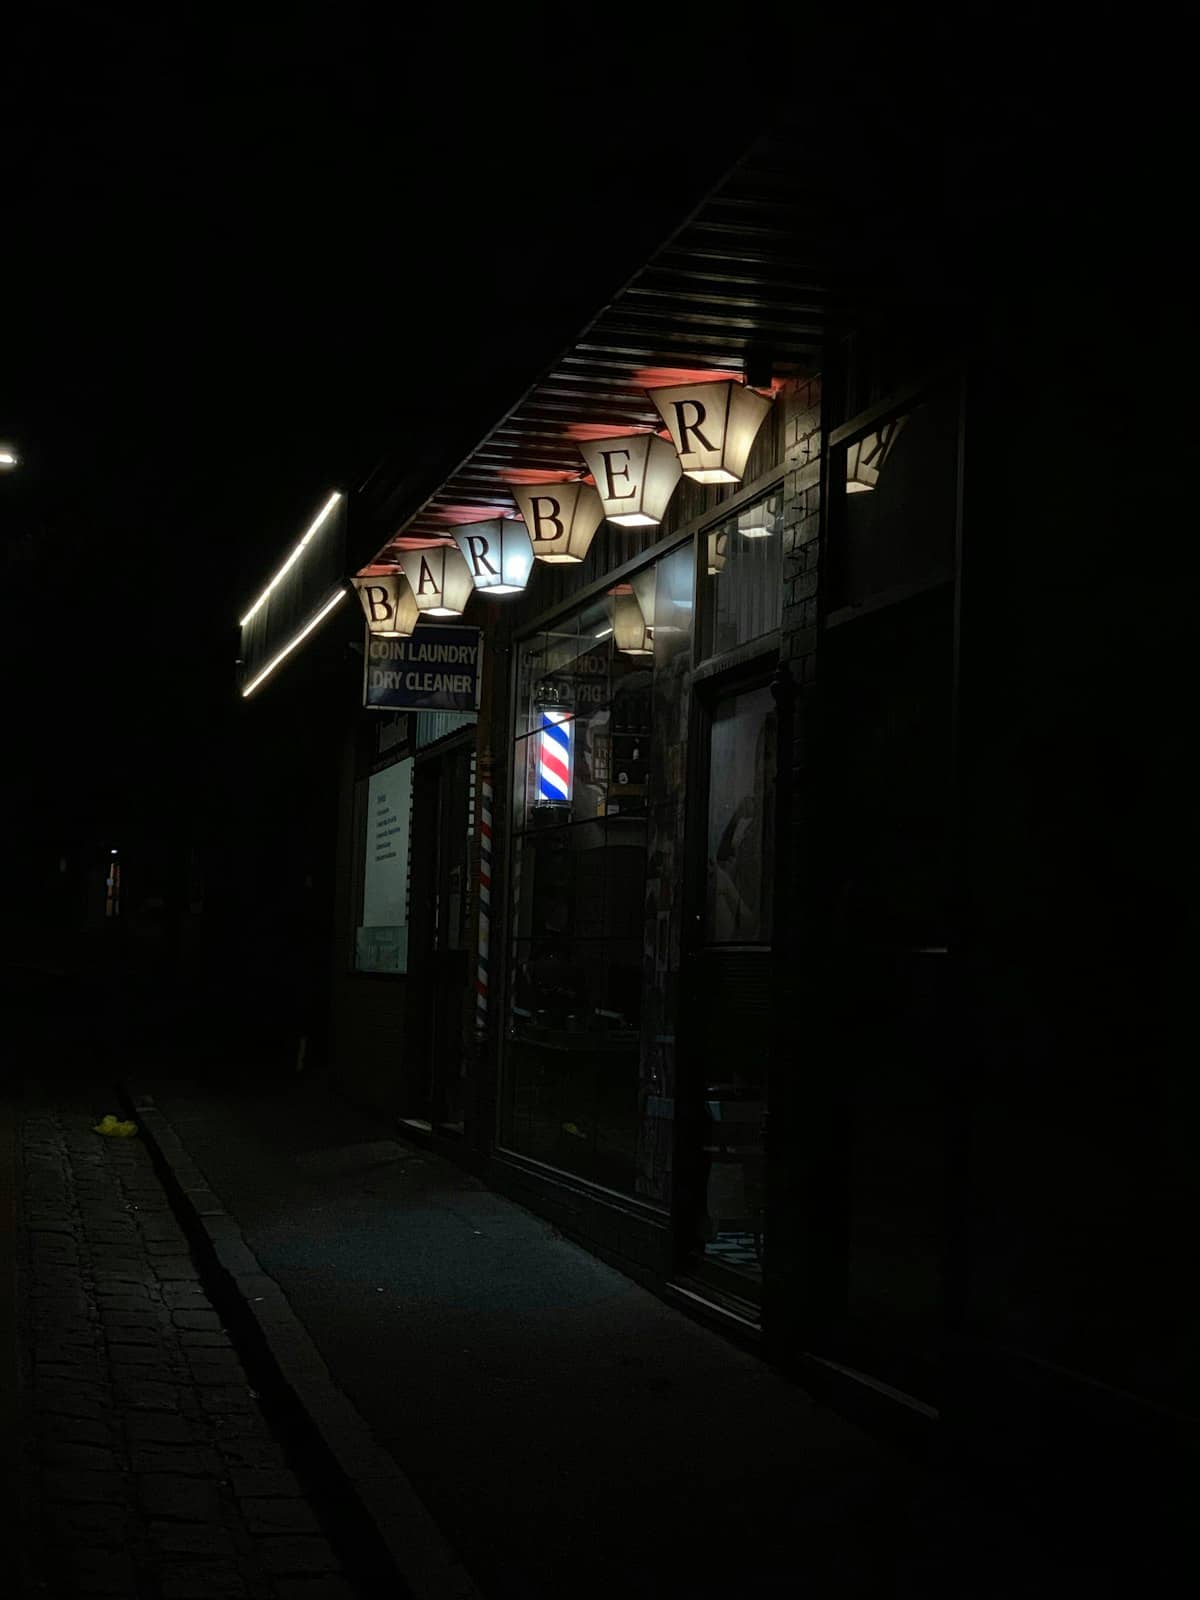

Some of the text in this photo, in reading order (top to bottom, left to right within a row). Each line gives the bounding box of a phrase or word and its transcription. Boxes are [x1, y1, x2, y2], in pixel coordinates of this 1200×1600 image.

[364, 399, 720, 622] BARBER
[370, 641, 477, 665] COIN LAUNDRY
[373, 670, 472, 694] DRY CLEANER
